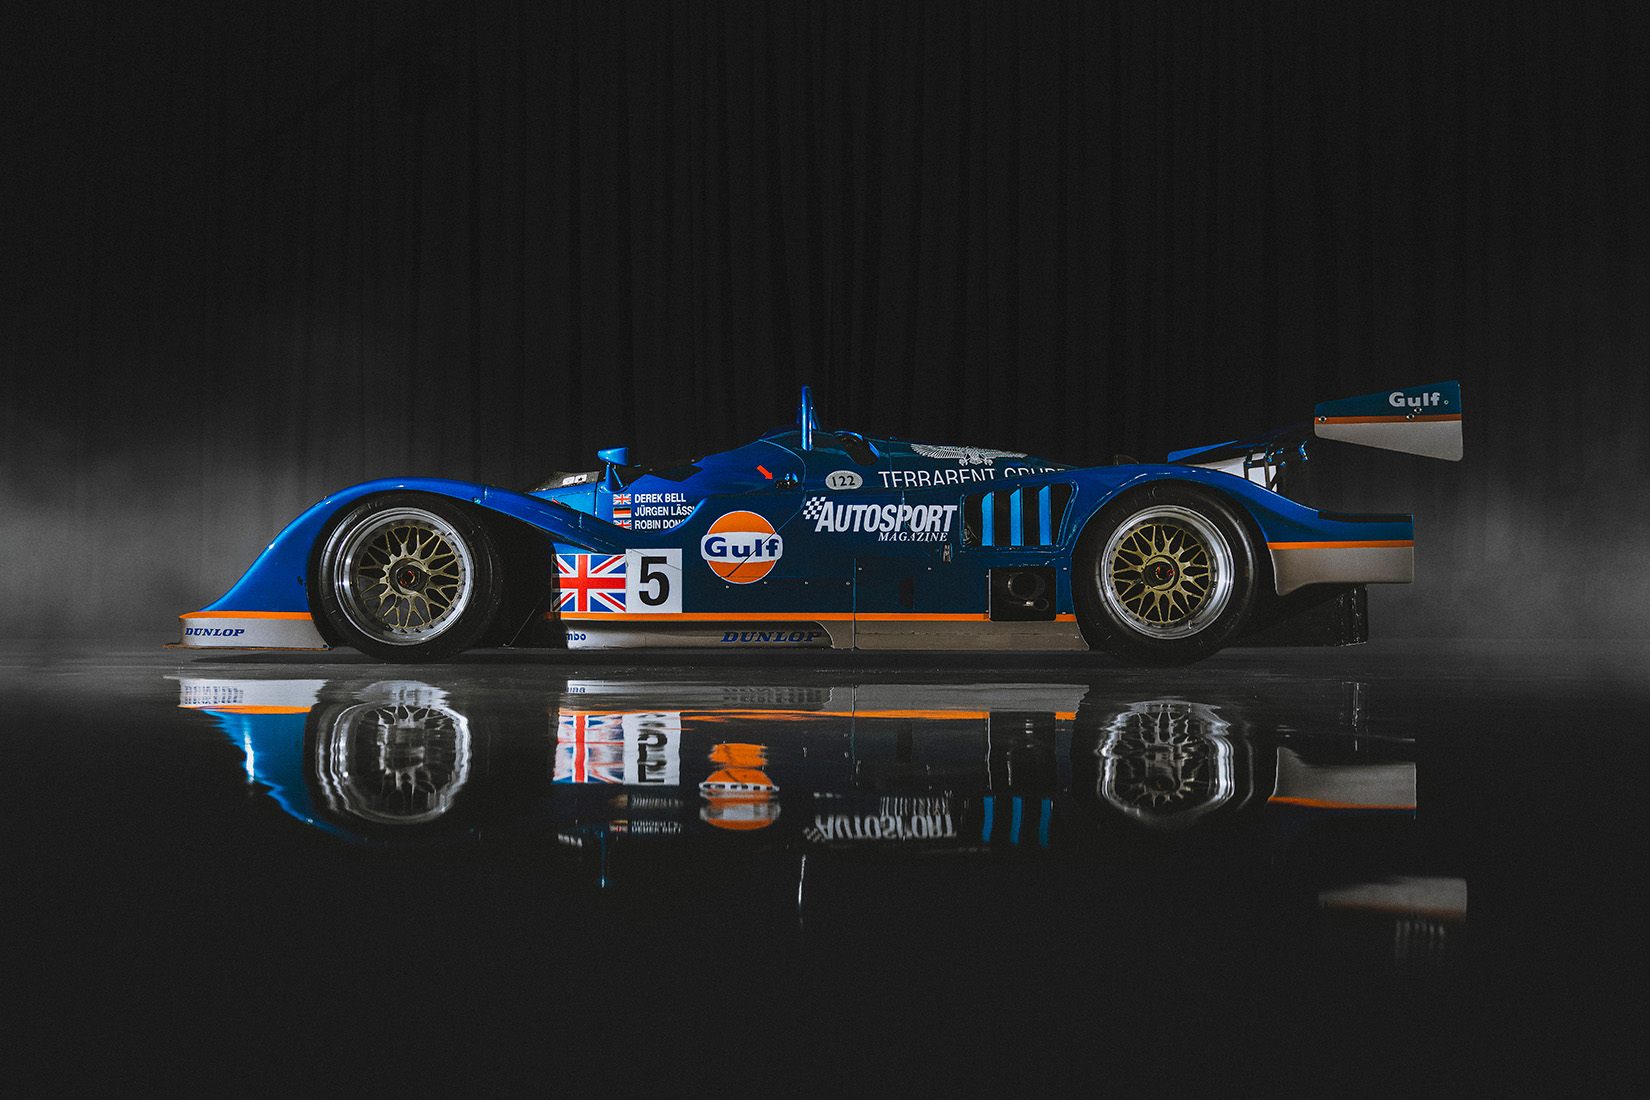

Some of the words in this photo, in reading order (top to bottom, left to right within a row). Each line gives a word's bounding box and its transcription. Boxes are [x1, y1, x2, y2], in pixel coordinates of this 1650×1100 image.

[1388, 391, 1441, 408] Gulf
[831, 475, 856, 487] 122
[634, 493, 664, 504] DEREK
[664, 492, 687, 503] BELL
[634, 504, 669, 517] JÜRGEN
[814, 501, 958, 533] AUTOSPORT
[634, 519, 661, 530] ROBIN
[662, 518, 685, 529] DON
[877, 531, 949, 542] MAGAZINE
[704, 536, 780, 558] Gulf
[638, 556, 670, 606] 5
[185, 627, 245, 637] DUNLOP
[720, 631, 822, 643] DUNLOP
